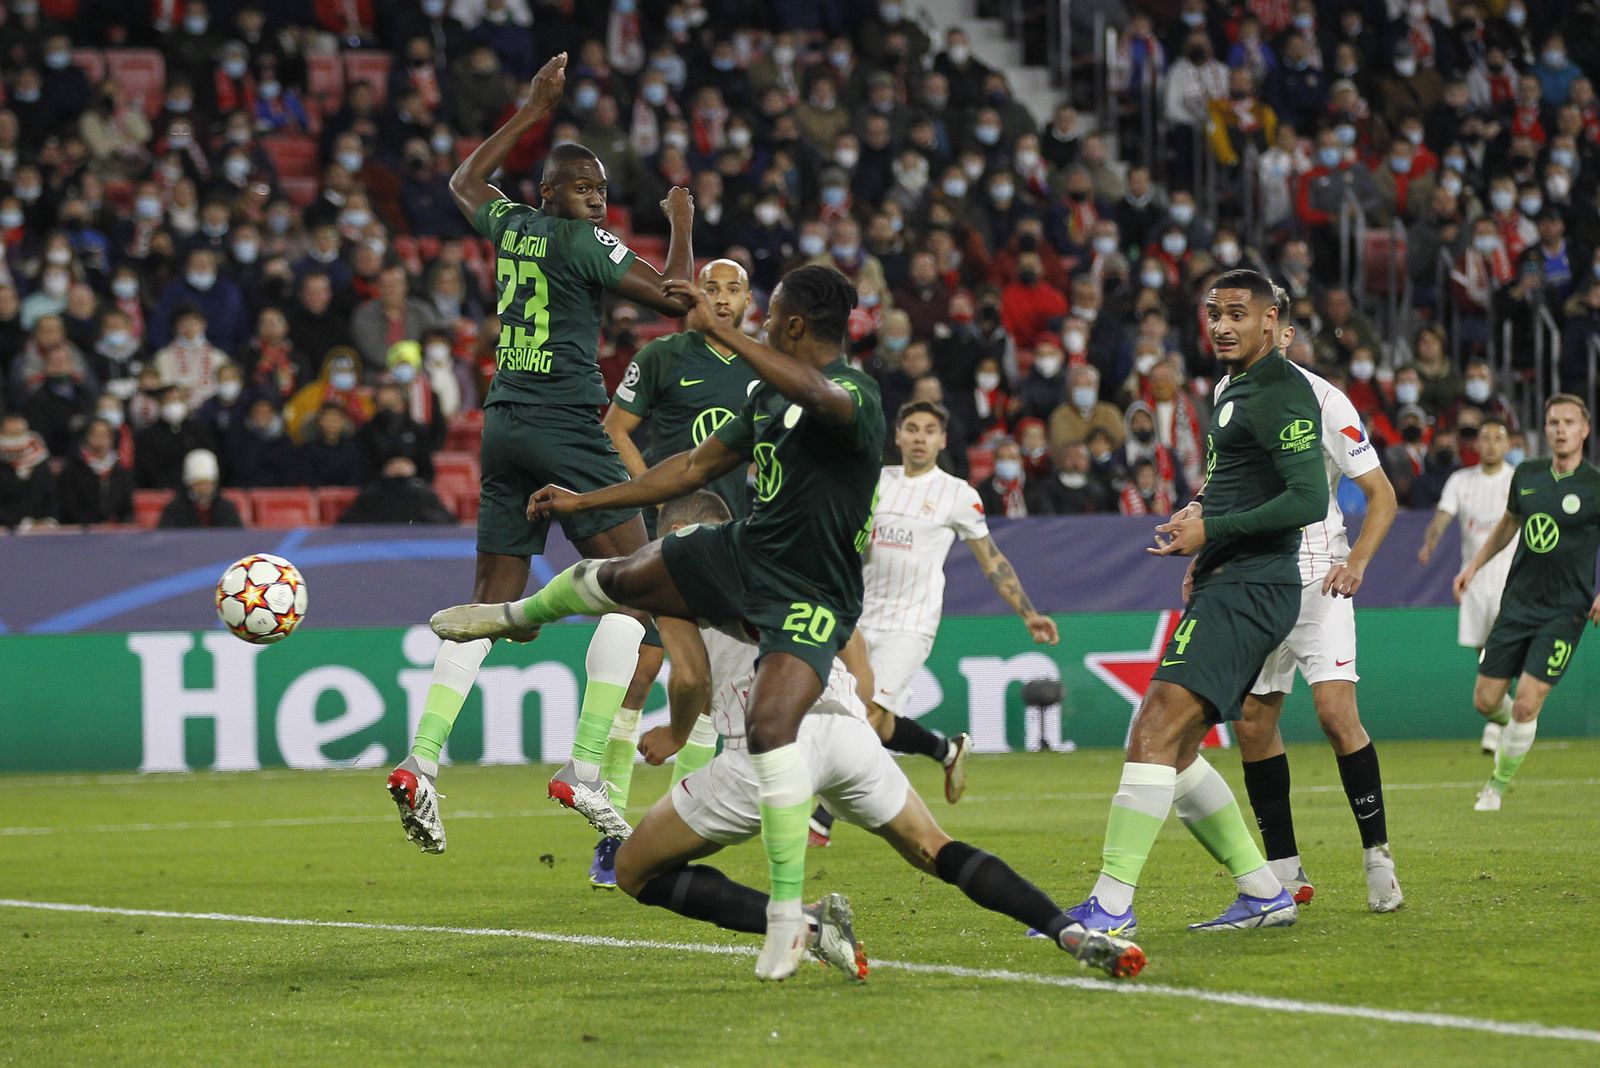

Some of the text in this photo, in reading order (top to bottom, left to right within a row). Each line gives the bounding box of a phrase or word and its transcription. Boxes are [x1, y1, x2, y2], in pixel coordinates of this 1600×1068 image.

[497, 258, 550, 349] 23
[782, 602, 836, 643] 20
[1173, 619, 1197, 655] 4
